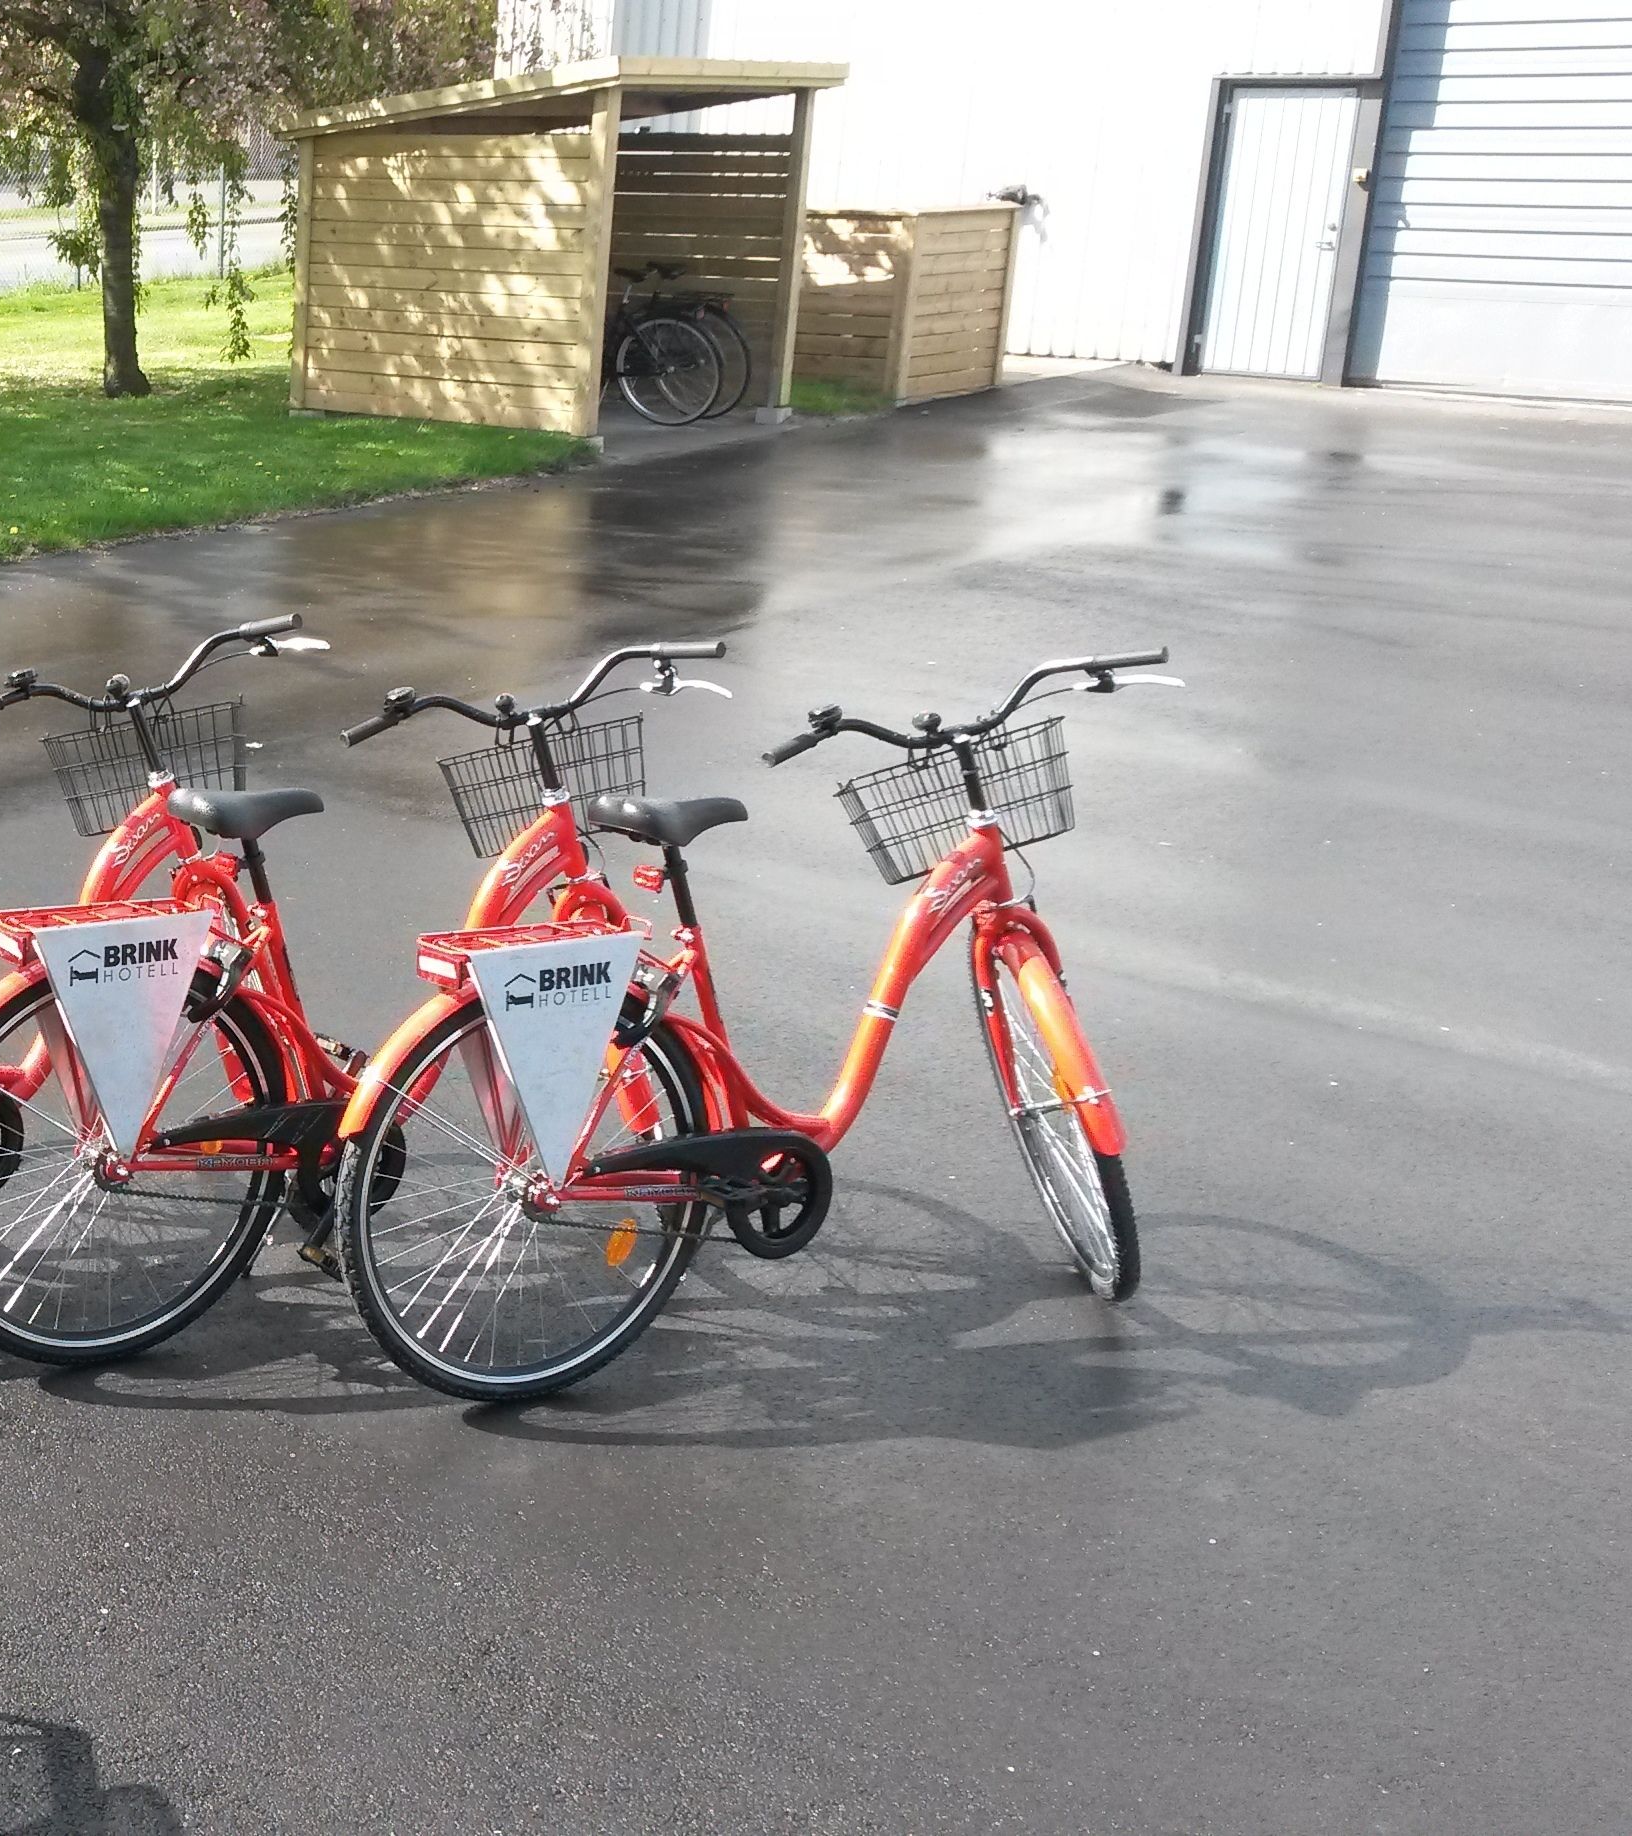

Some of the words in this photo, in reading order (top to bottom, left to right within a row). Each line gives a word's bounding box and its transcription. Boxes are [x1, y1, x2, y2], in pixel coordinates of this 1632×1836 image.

[103, 938, 179, 968] BRINK
[103, 962, 179, 983] HOTELL
[539, 961, 612, 992] BRINK
[538, 986, 612, 1008] HOTELL
